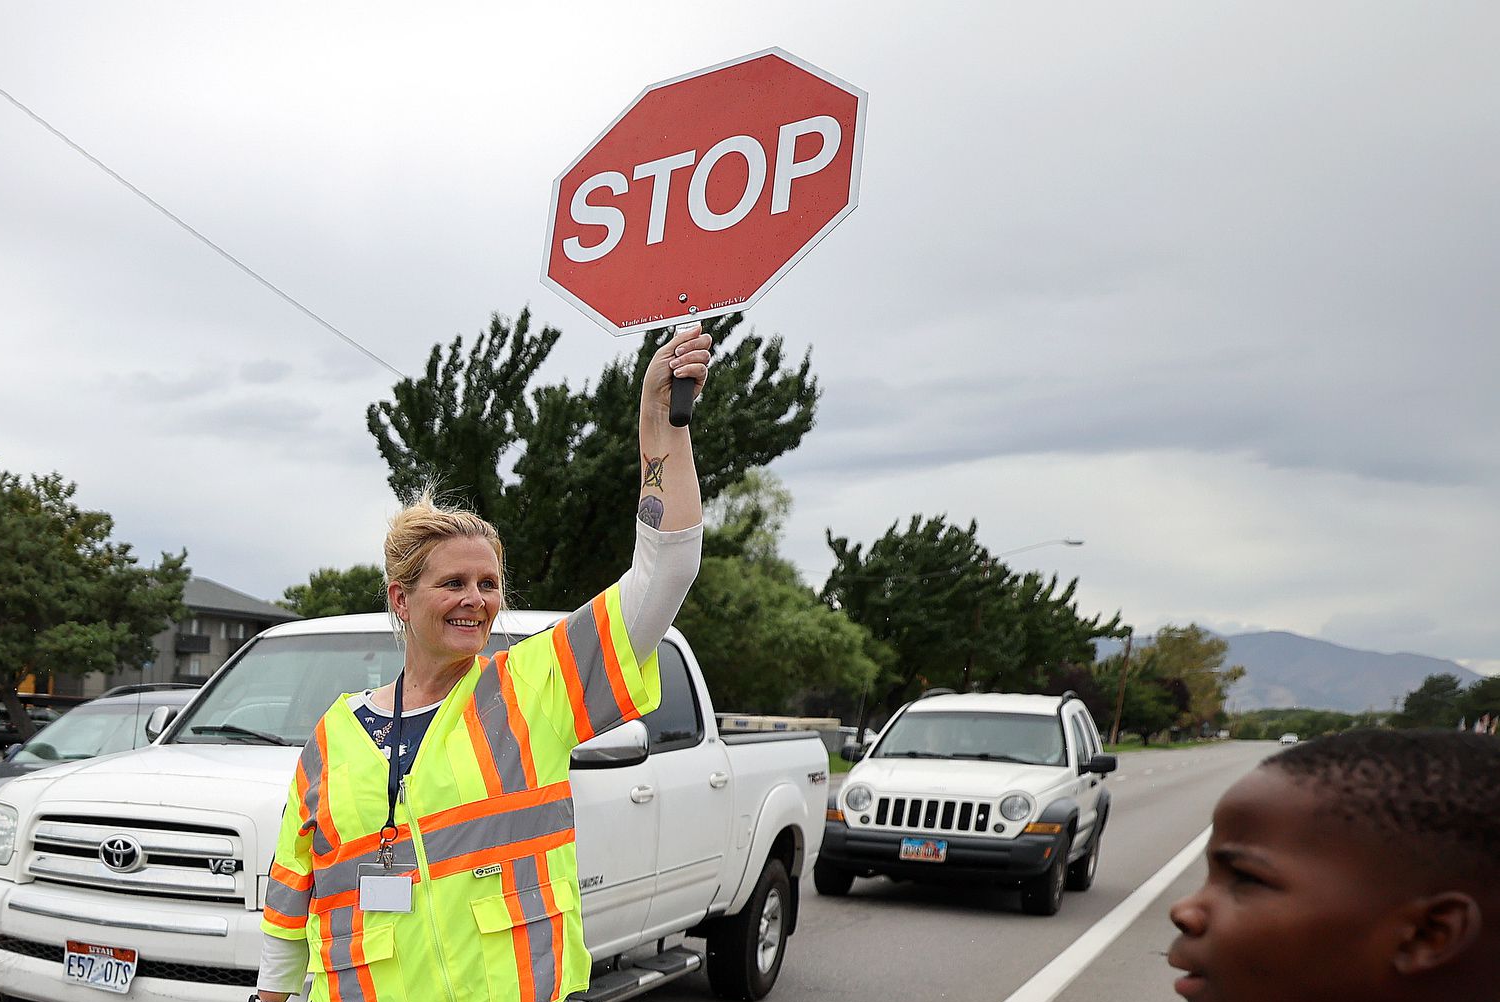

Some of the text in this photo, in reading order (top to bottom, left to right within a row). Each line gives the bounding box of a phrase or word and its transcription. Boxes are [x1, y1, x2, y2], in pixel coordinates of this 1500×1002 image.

[562, 115, 842, 263] STOP
[620, 319, 639, 327] Made
[648, 314, 664, 322] USA
[208, 858, 237, 874] V8
[88, 945, 114, 957] UTAH
[67, 954, 95, 980] E57
